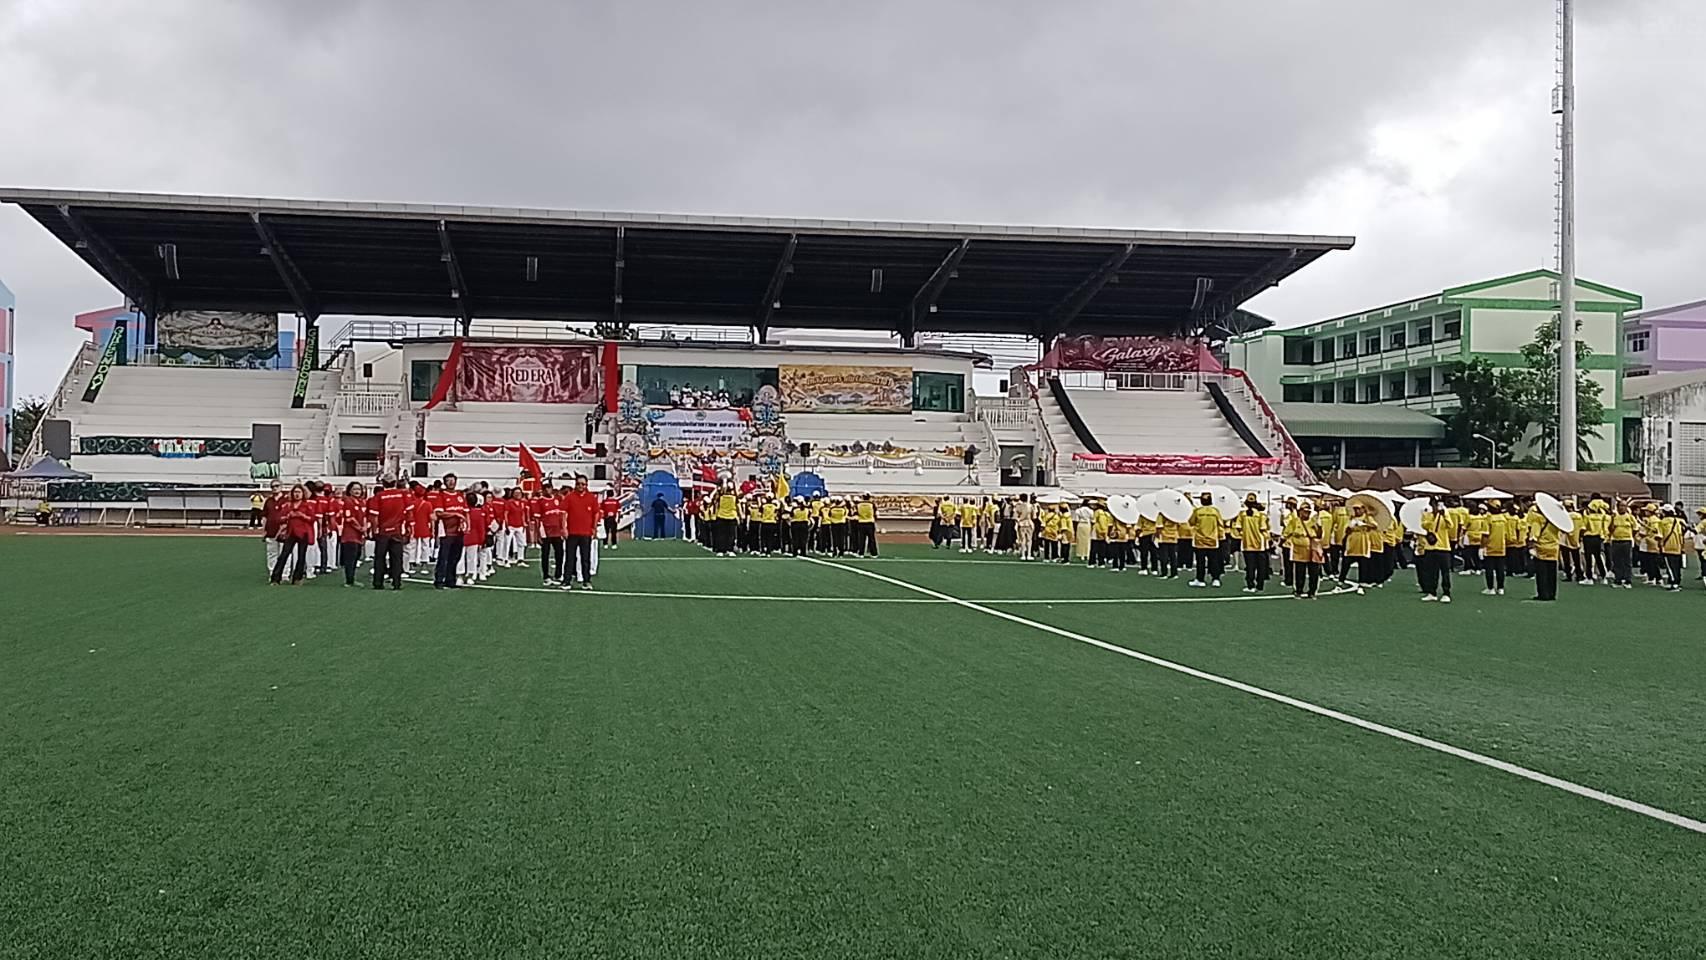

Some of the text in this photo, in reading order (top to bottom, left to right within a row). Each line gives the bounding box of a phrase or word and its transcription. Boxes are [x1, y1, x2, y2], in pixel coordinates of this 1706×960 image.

[1093, 347, 1168, 364] Galaxy
[504, 365, 553, 386] RED ERA
